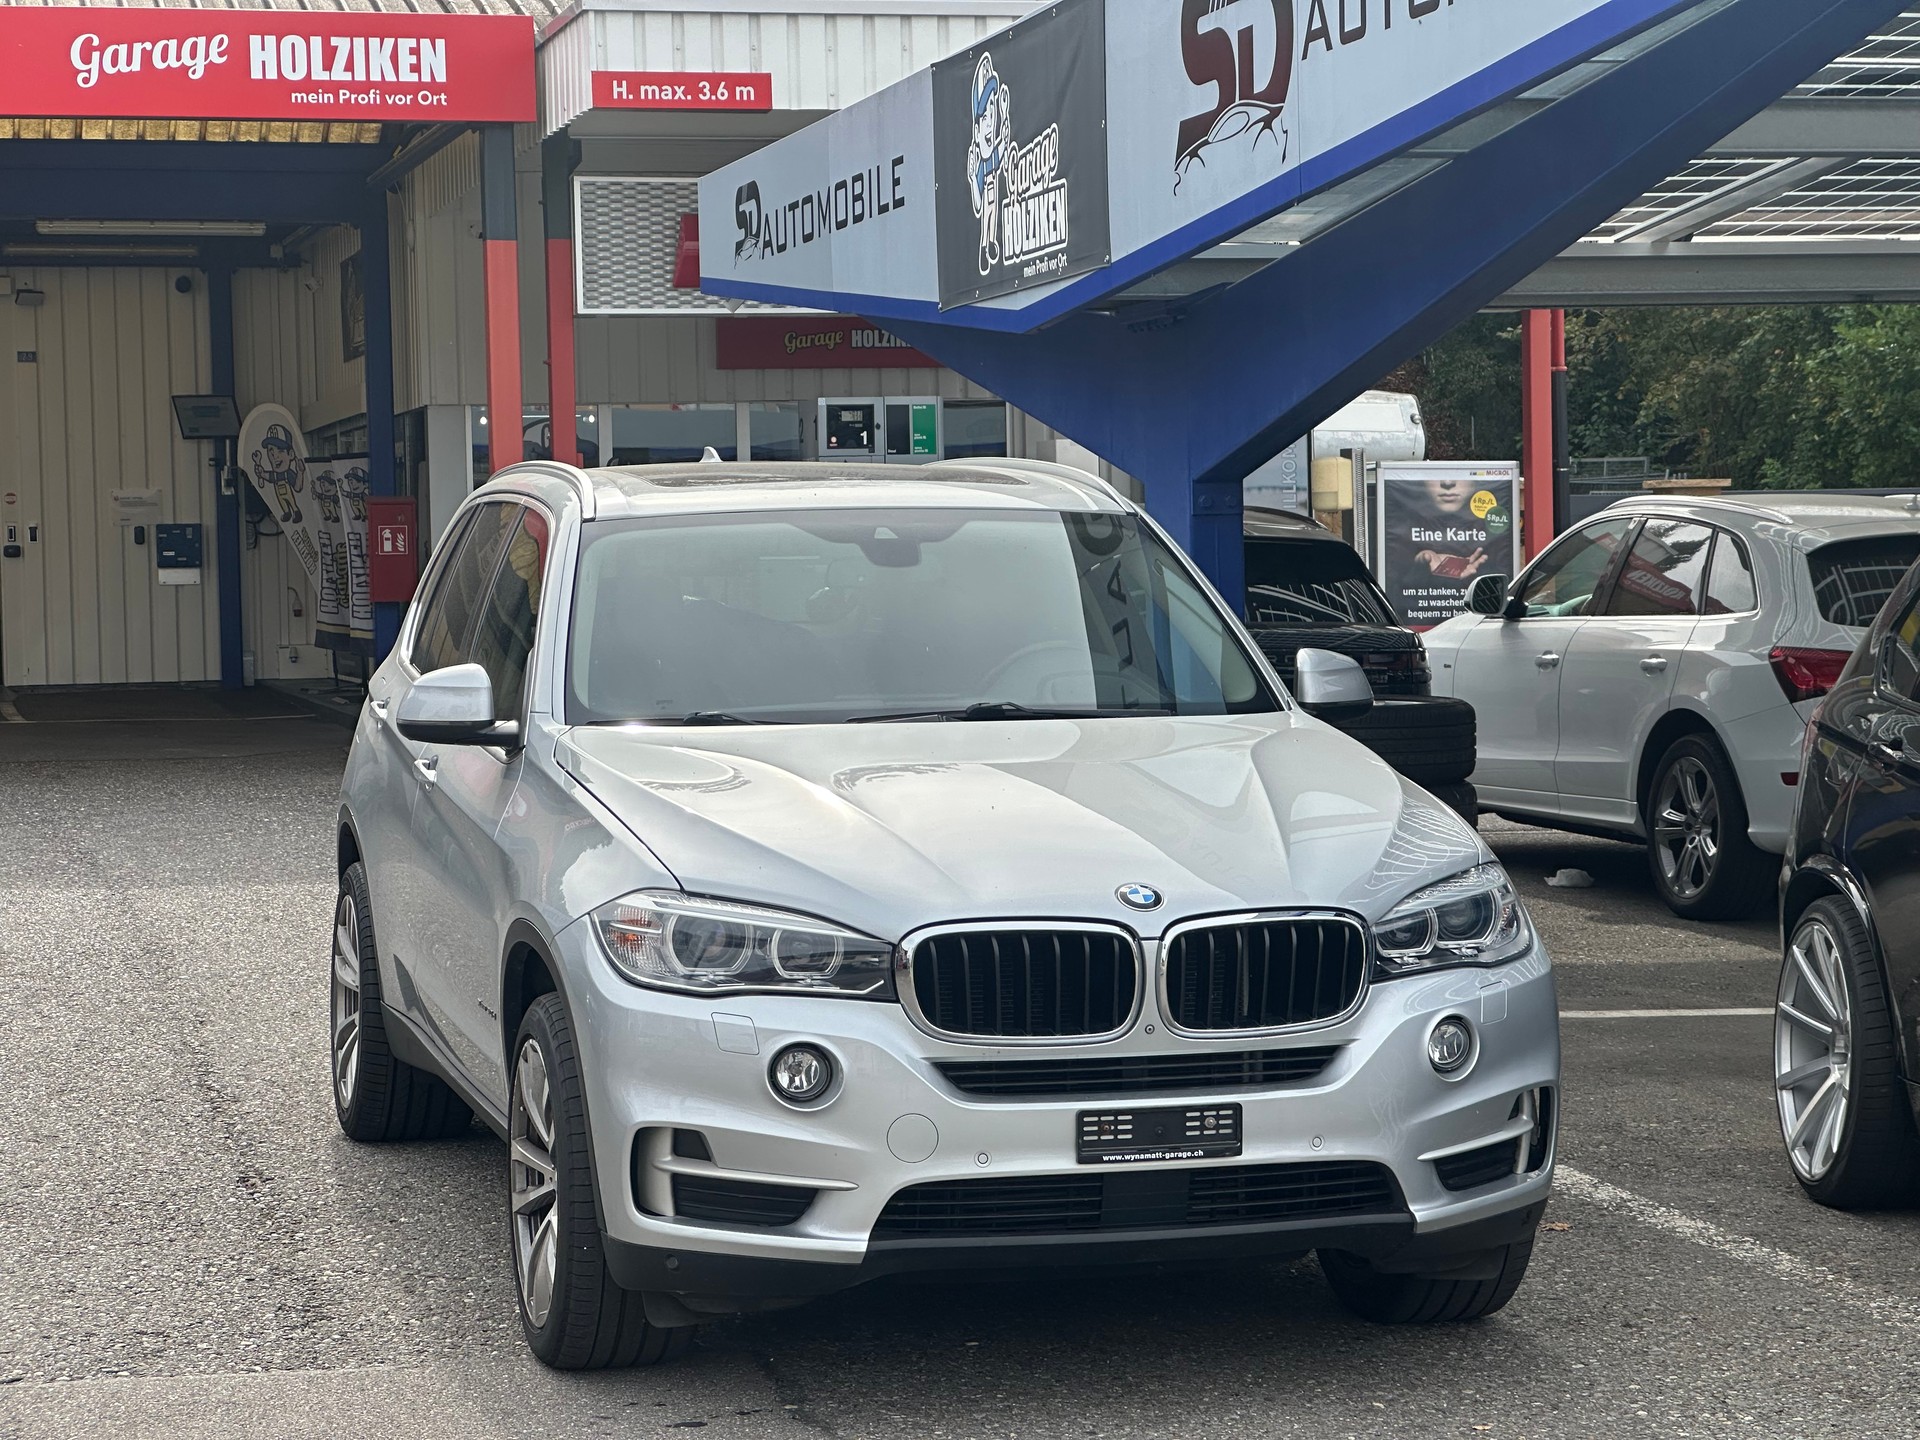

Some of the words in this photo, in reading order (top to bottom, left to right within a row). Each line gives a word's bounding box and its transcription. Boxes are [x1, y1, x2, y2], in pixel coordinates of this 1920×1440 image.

[70, 33, 229, 88] Garage
[249, 34, 447, 83] HOLZIKEN
[291, 90, 334, 104] mein
[339, 89, 380, 105] Profi
[385, 93, 415, 105] vor
[417, 90, 447, 106] Ort
[612, 80, 634, 100] H.
[640, 84, 692, 100] max.
[698, 81, 729, 101] 3.6
[735, 85, 755, 101] m
[1007, 131, 1058, 206] Garage
[761, 154, 905, 260] AUTOMOBILE
[1003, 186, 1066, 258] HOLZIKEN
[1023, 261, 1036, 278] mein
[1036, 256, 1049, 274] Profi
[1049, 259, 1058, 272] vor
[1058, 252, 1068, 268] Ort
[784, 331, 844, 354] Garage
[860, 430, 868, 445] 1
[1411, 527, 1442, 541] Eine
[1446, 527, 1487, 541] Karte
[1402, 588, 1416, 596] um
[1417, 588, 1428, 596] zu
[1429, 587, 1459, 597] tanken,
[1418, 599, 1428, 607] zu
[1429, 598, 1465, 607] waschen
[1407, 609, 1441, 620] bequem
[1441, 610, 1451, 618] zu
[1102, 1149, 1204, 1162] www.wynamatt-garage.ch
